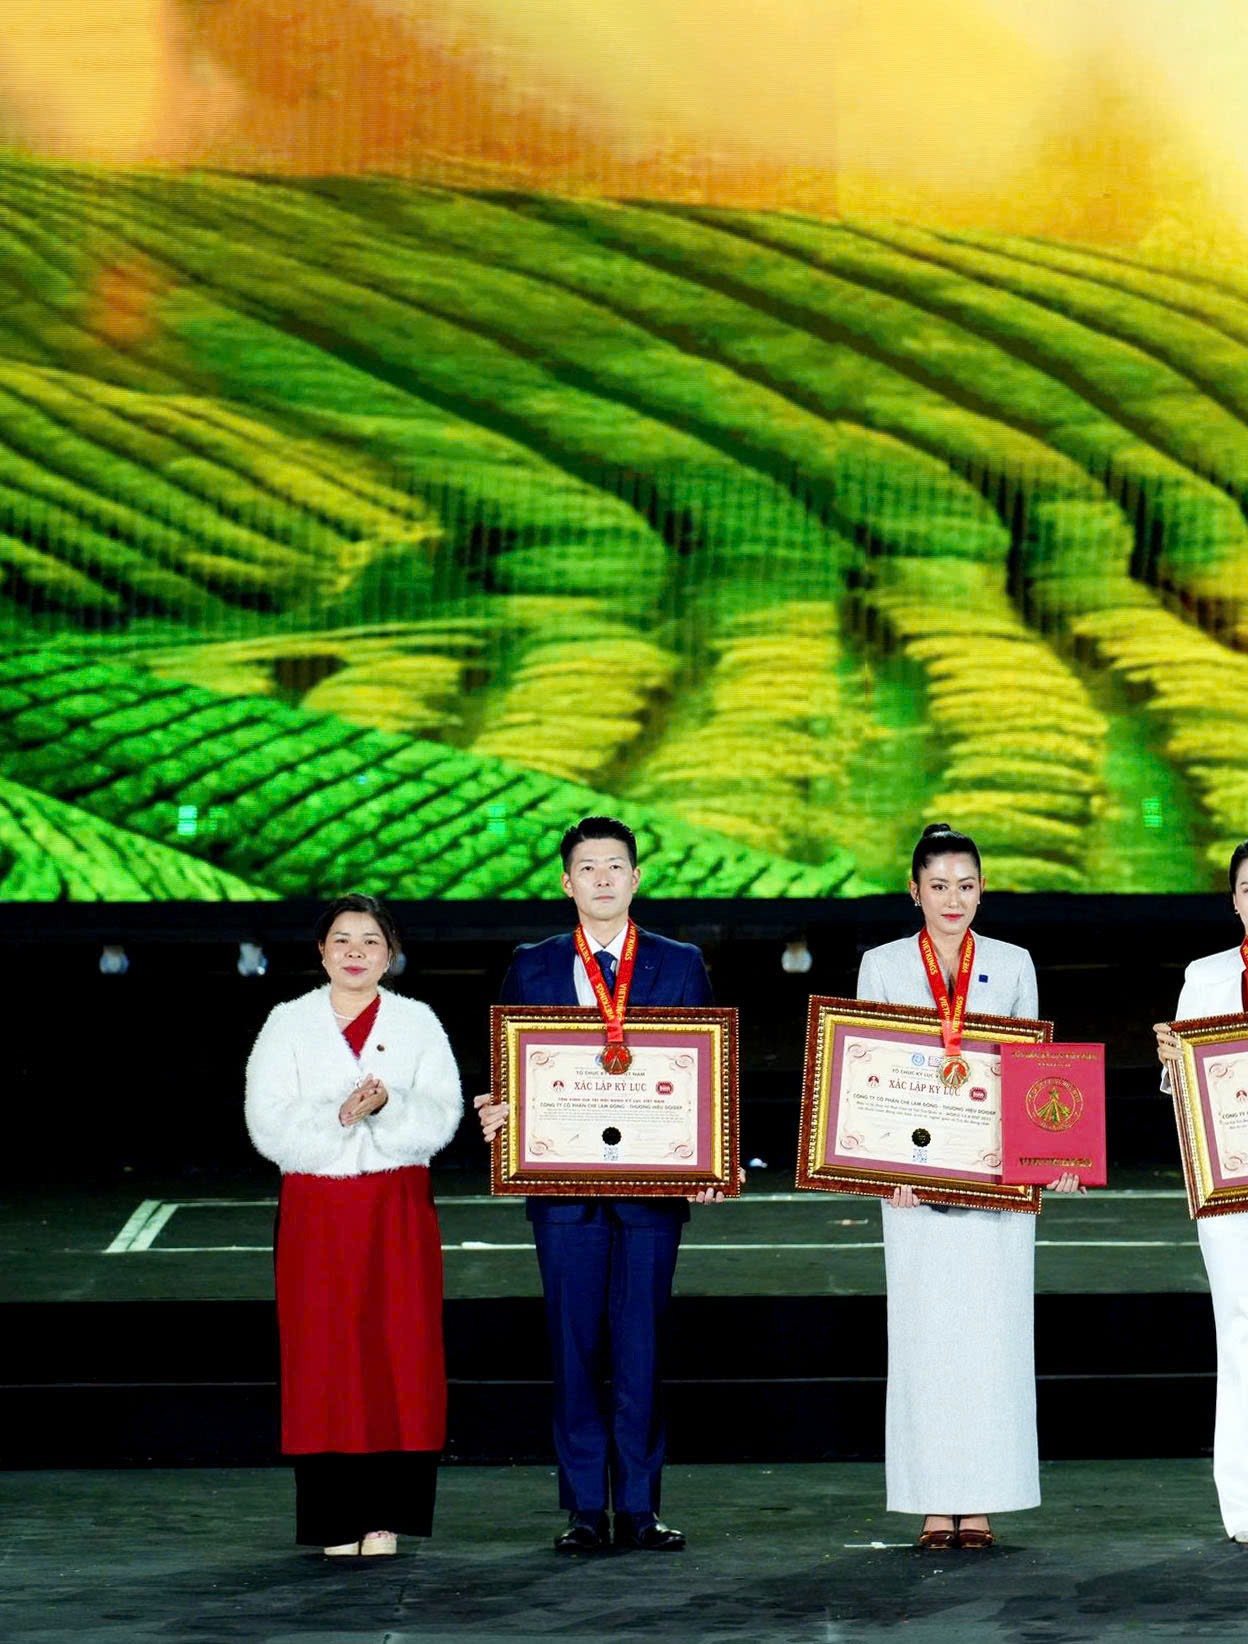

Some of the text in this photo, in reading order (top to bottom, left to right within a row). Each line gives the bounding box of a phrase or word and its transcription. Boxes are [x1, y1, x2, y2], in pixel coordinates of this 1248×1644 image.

[921, 937, 938, 976] VIETKINGS
[596, 983, 616, 1020] VIETKINGS
[951, 995, 965, 1033] VIETKINGS
